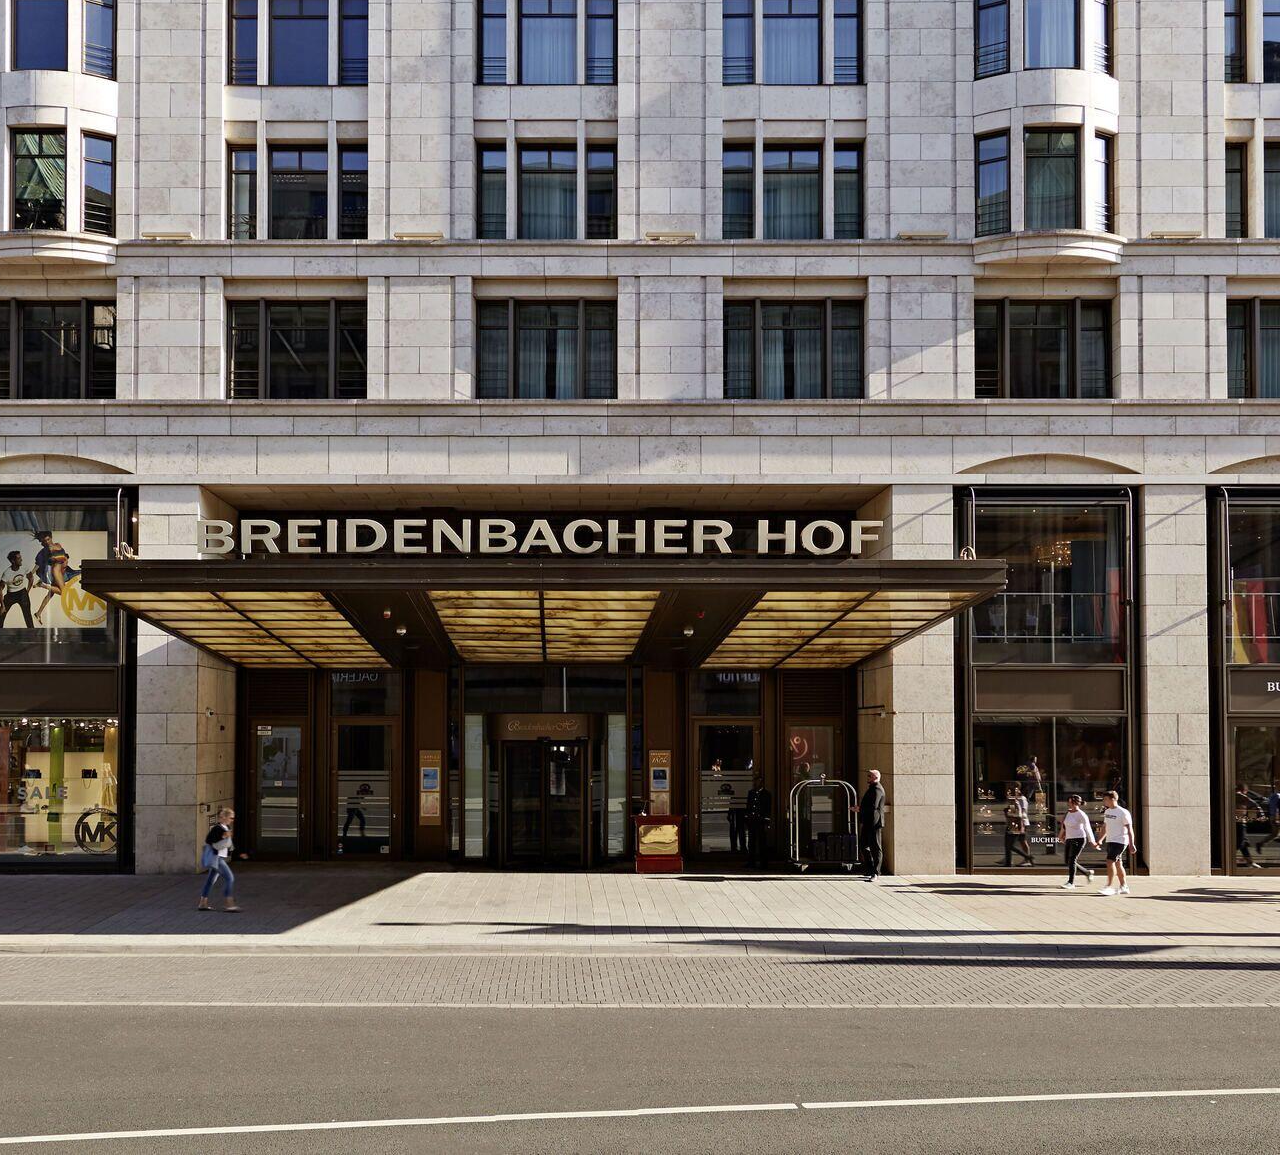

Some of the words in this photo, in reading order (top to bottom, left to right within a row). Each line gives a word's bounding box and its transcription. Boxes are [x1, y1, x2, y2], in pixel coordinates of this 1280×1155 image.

[197, 518, 734, 554] BREIDENBACHER
[757, 518, 884, 555] HOF
[17, 786, 68, 800] SALE
[81, 821, 117, 843] MK
